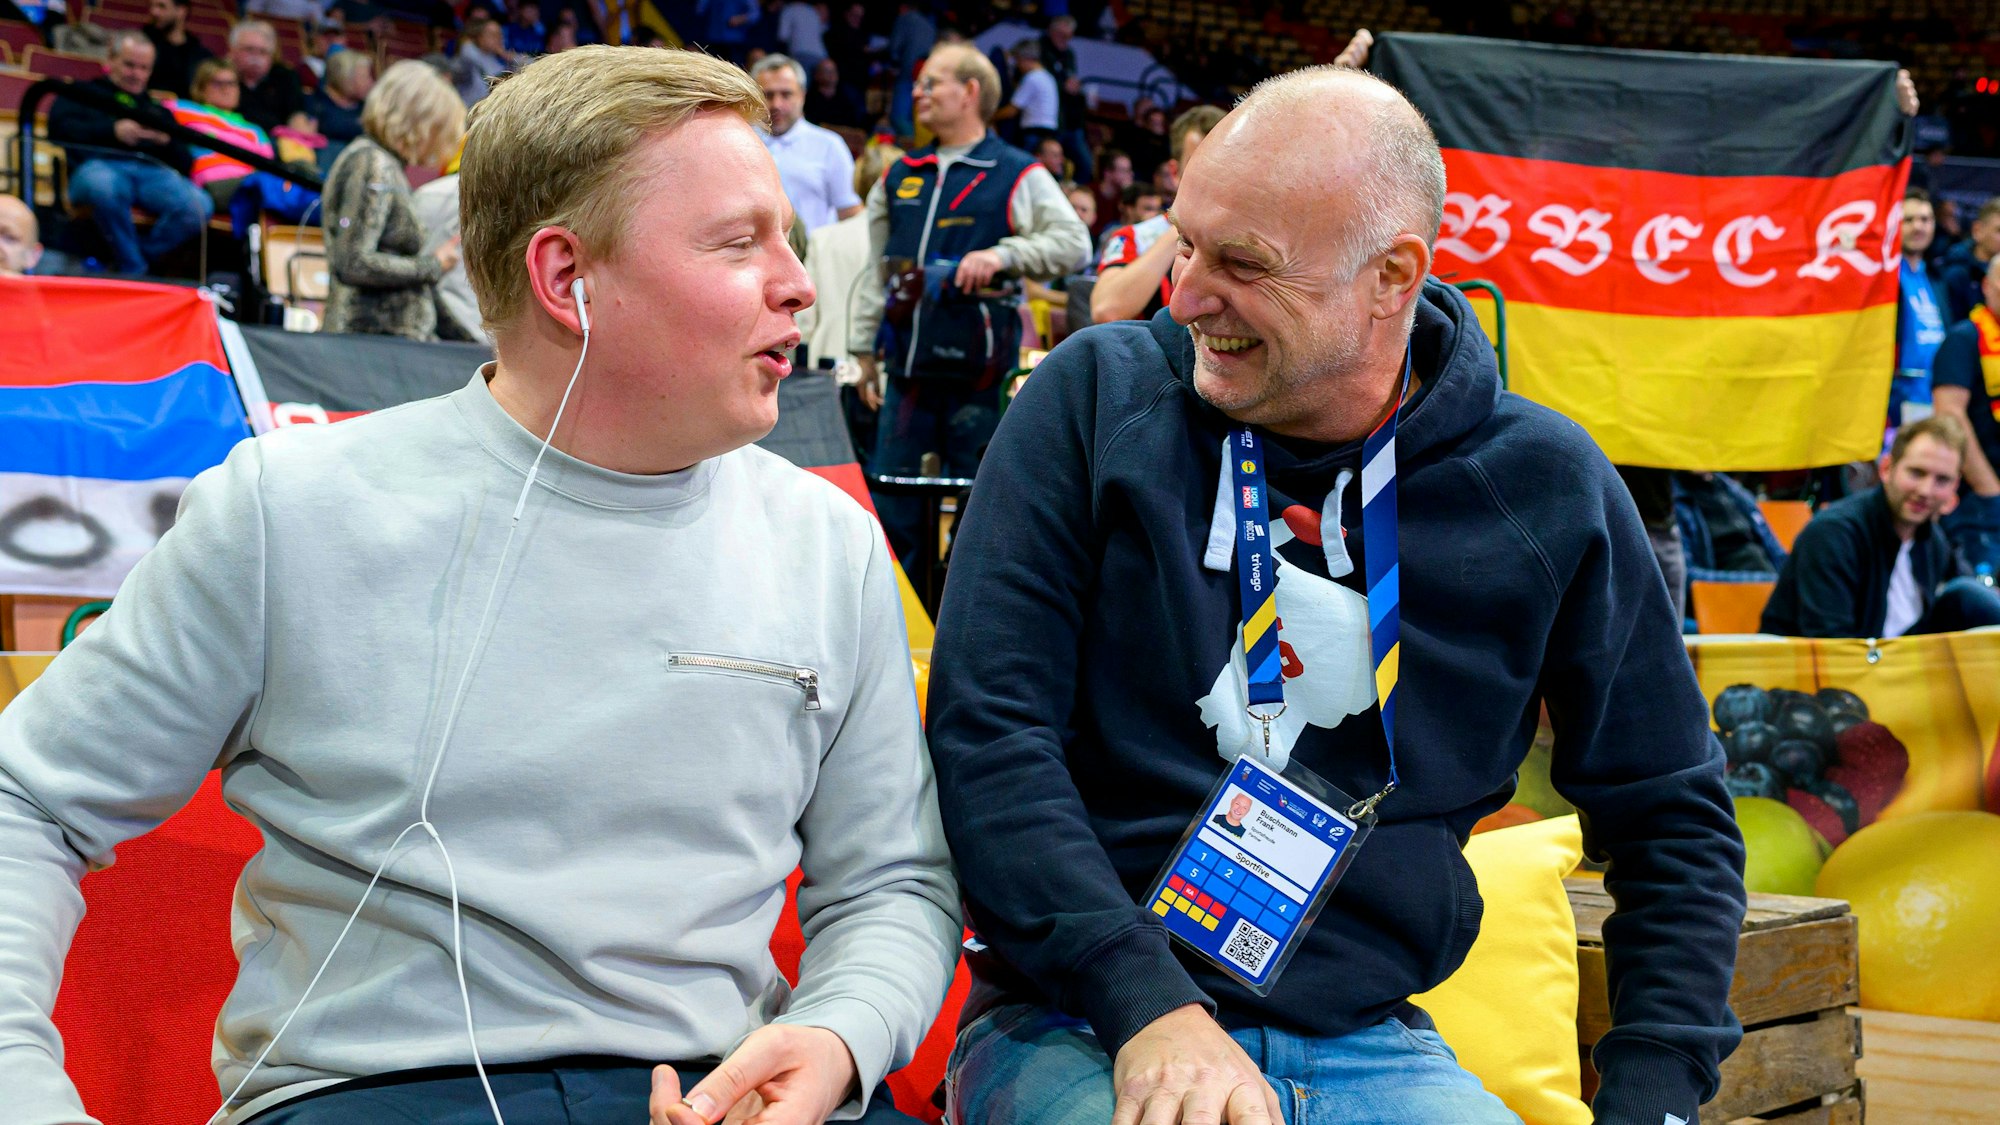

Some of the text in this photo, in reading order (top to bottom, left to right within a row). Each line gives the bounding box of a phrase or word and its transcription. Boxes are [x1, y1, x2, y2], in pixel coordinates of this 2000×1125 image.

[1243, 487, 1252, 508] MOLY
[1250, 552, 1262, 592] trivago
[1255, 816, 1275, 832] Frank
[1260, 809, 1298, 838] Buschmann
[1200, 852, 1207, 862] 1
[1190, 867, 1199, 878] 5
[1224, 868, 1234, 879] 2
[1235, 852, 1270, 879] Sportfive
[1278, 904, 1287, 913] 4
